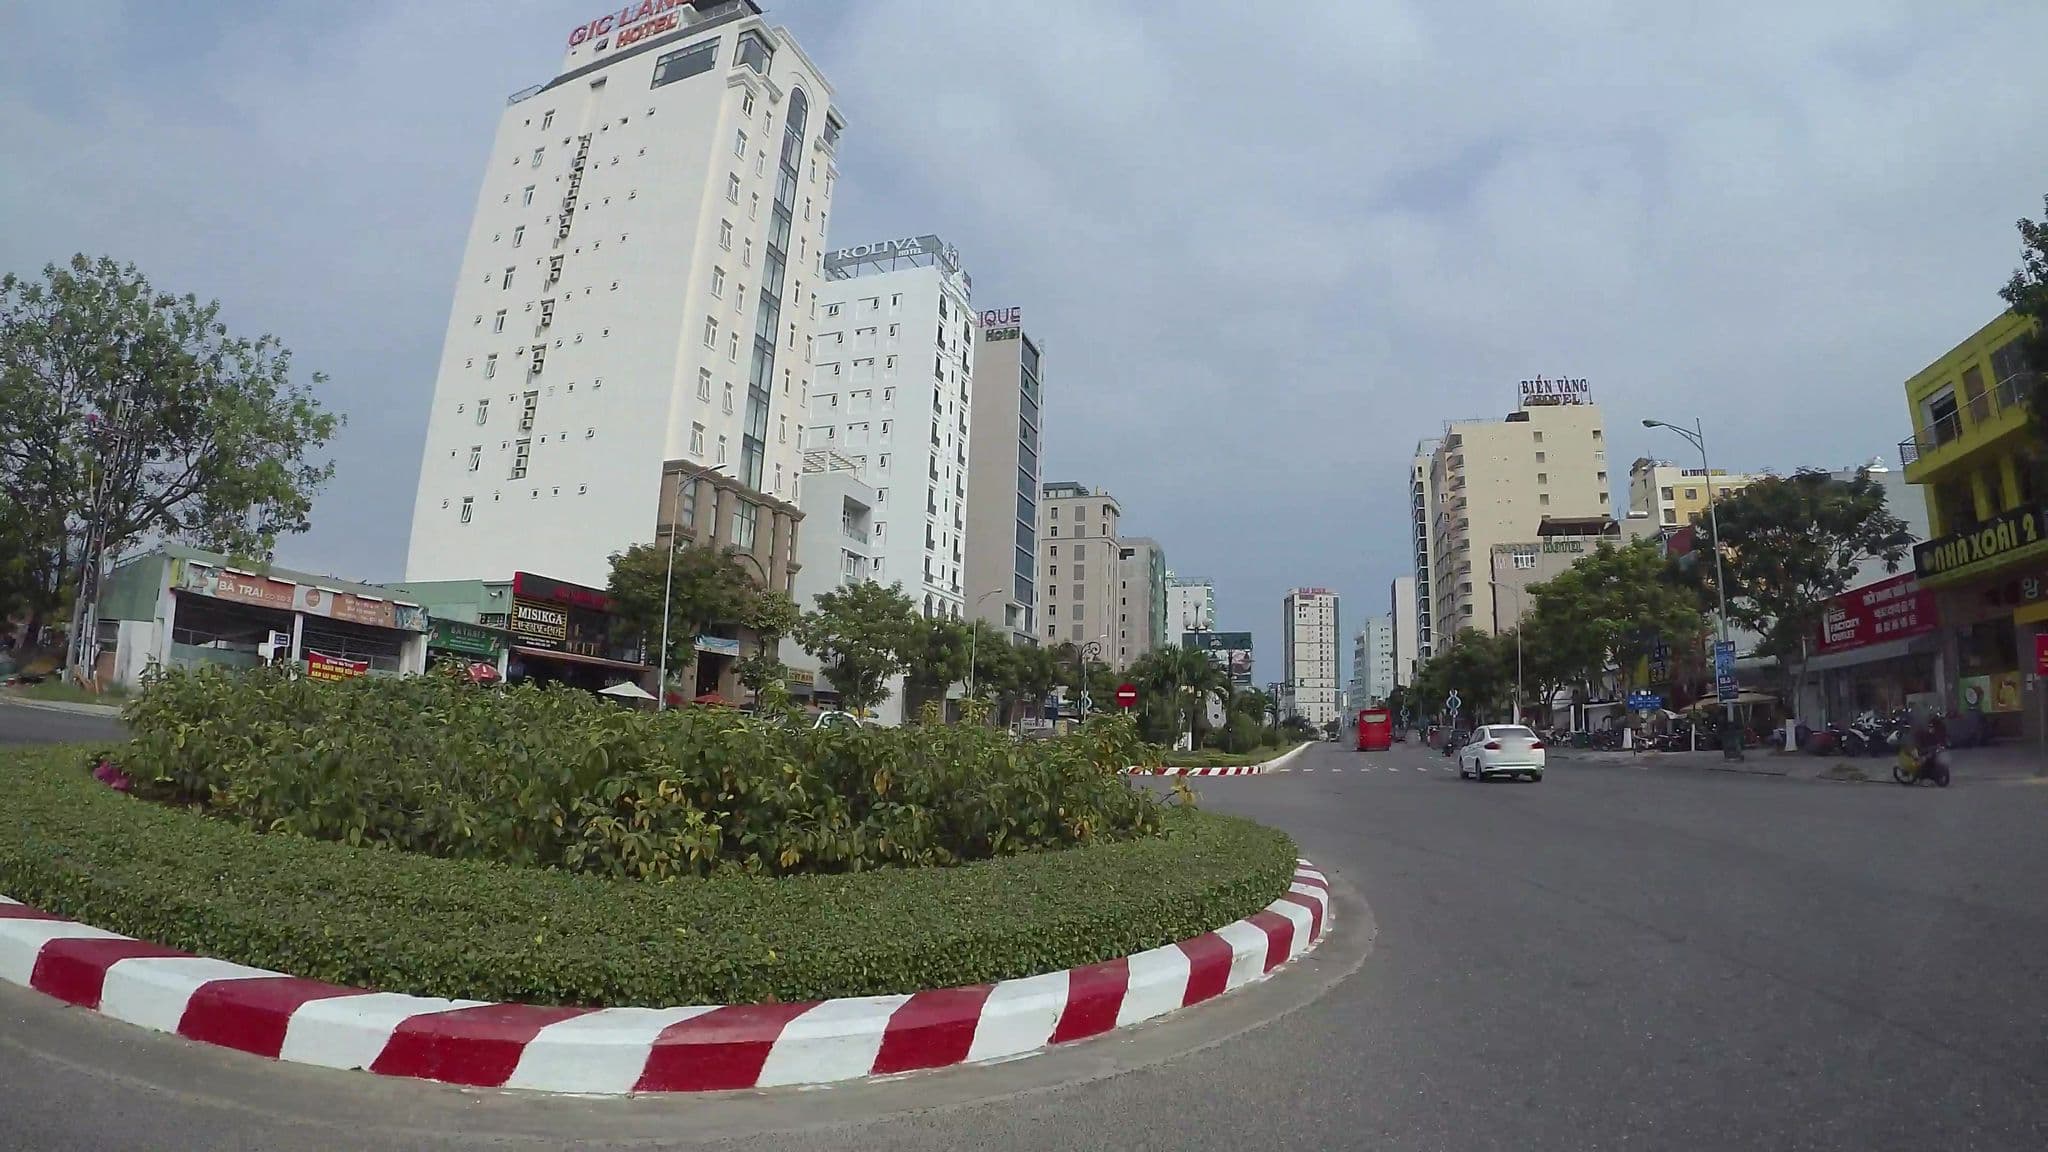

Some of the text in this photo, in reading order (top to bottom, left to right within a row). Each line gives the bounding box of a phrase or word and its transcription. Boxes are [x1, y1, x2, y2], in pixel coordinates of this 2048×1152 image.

[568, 0, 694, 46] GIC LAN
[616, 11, 679, 48] HOTEL
[837, 236, 922, 261] ROLIVA
[898, 247, 923, 257] HOTEL
[1557, 376, 1588, 393] VÀNG
[1543, 541, 1585, 553] HOTEL
[1970, 517, 2018, 560] XOÀI
[2022, 512, 2038, 541] 2
[517, 606, 563, 625] MISIKGA
